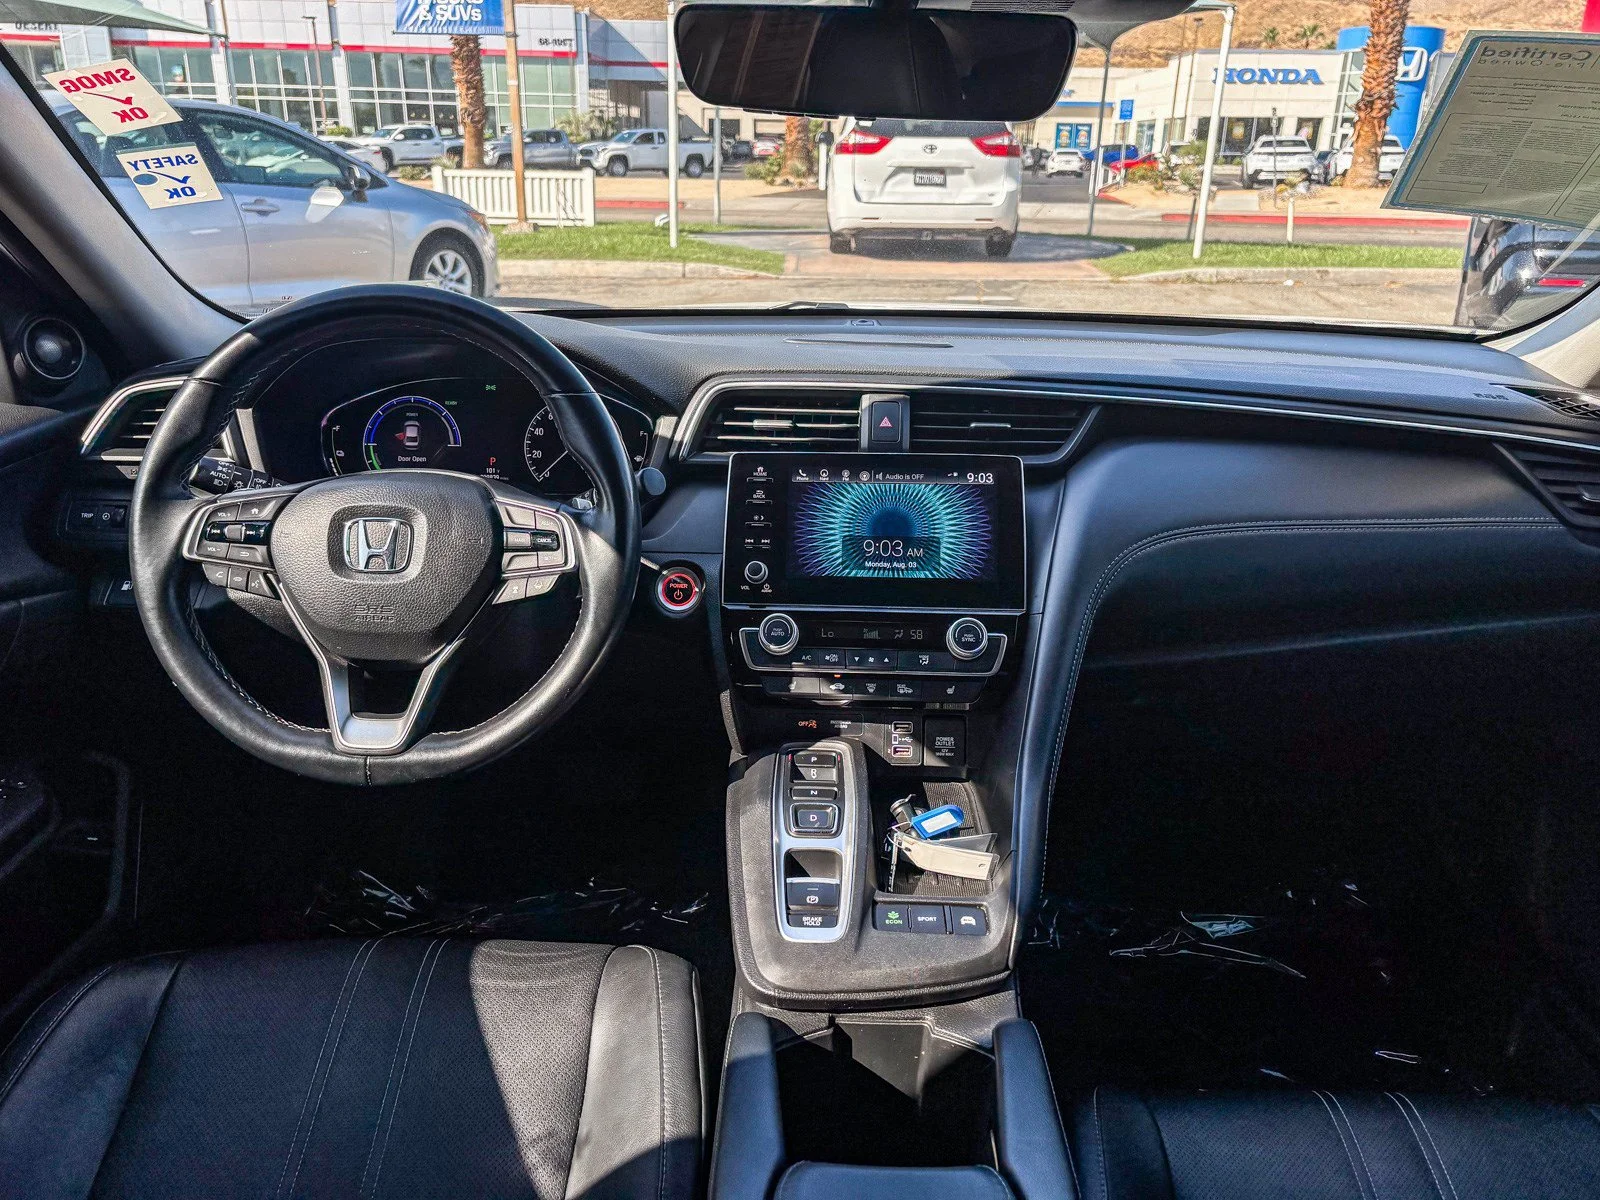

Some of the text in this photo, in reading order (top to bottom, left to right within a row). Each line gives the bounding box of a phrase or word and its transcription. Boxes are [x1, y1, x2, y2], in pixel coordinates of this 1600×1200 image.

[419, 4, 482, 21] & SUVs
[1212, 67, 1324, 85] HONDA
[534, 427, 544, 436] 40
[532, 450, 542, 459] 20
[490, 456, 497, 466] P
[210, 470, 227, 479] AUTO
[967, 472, 994, 483] 9:03
[863, 539, 924, 557] 9:03 AM
[865, 561, 892, 569] Monday,
[893, 561, 907, 569] Aug.
[821, 628, 834, 638] Lo
[810, 814, 818, 822] D
